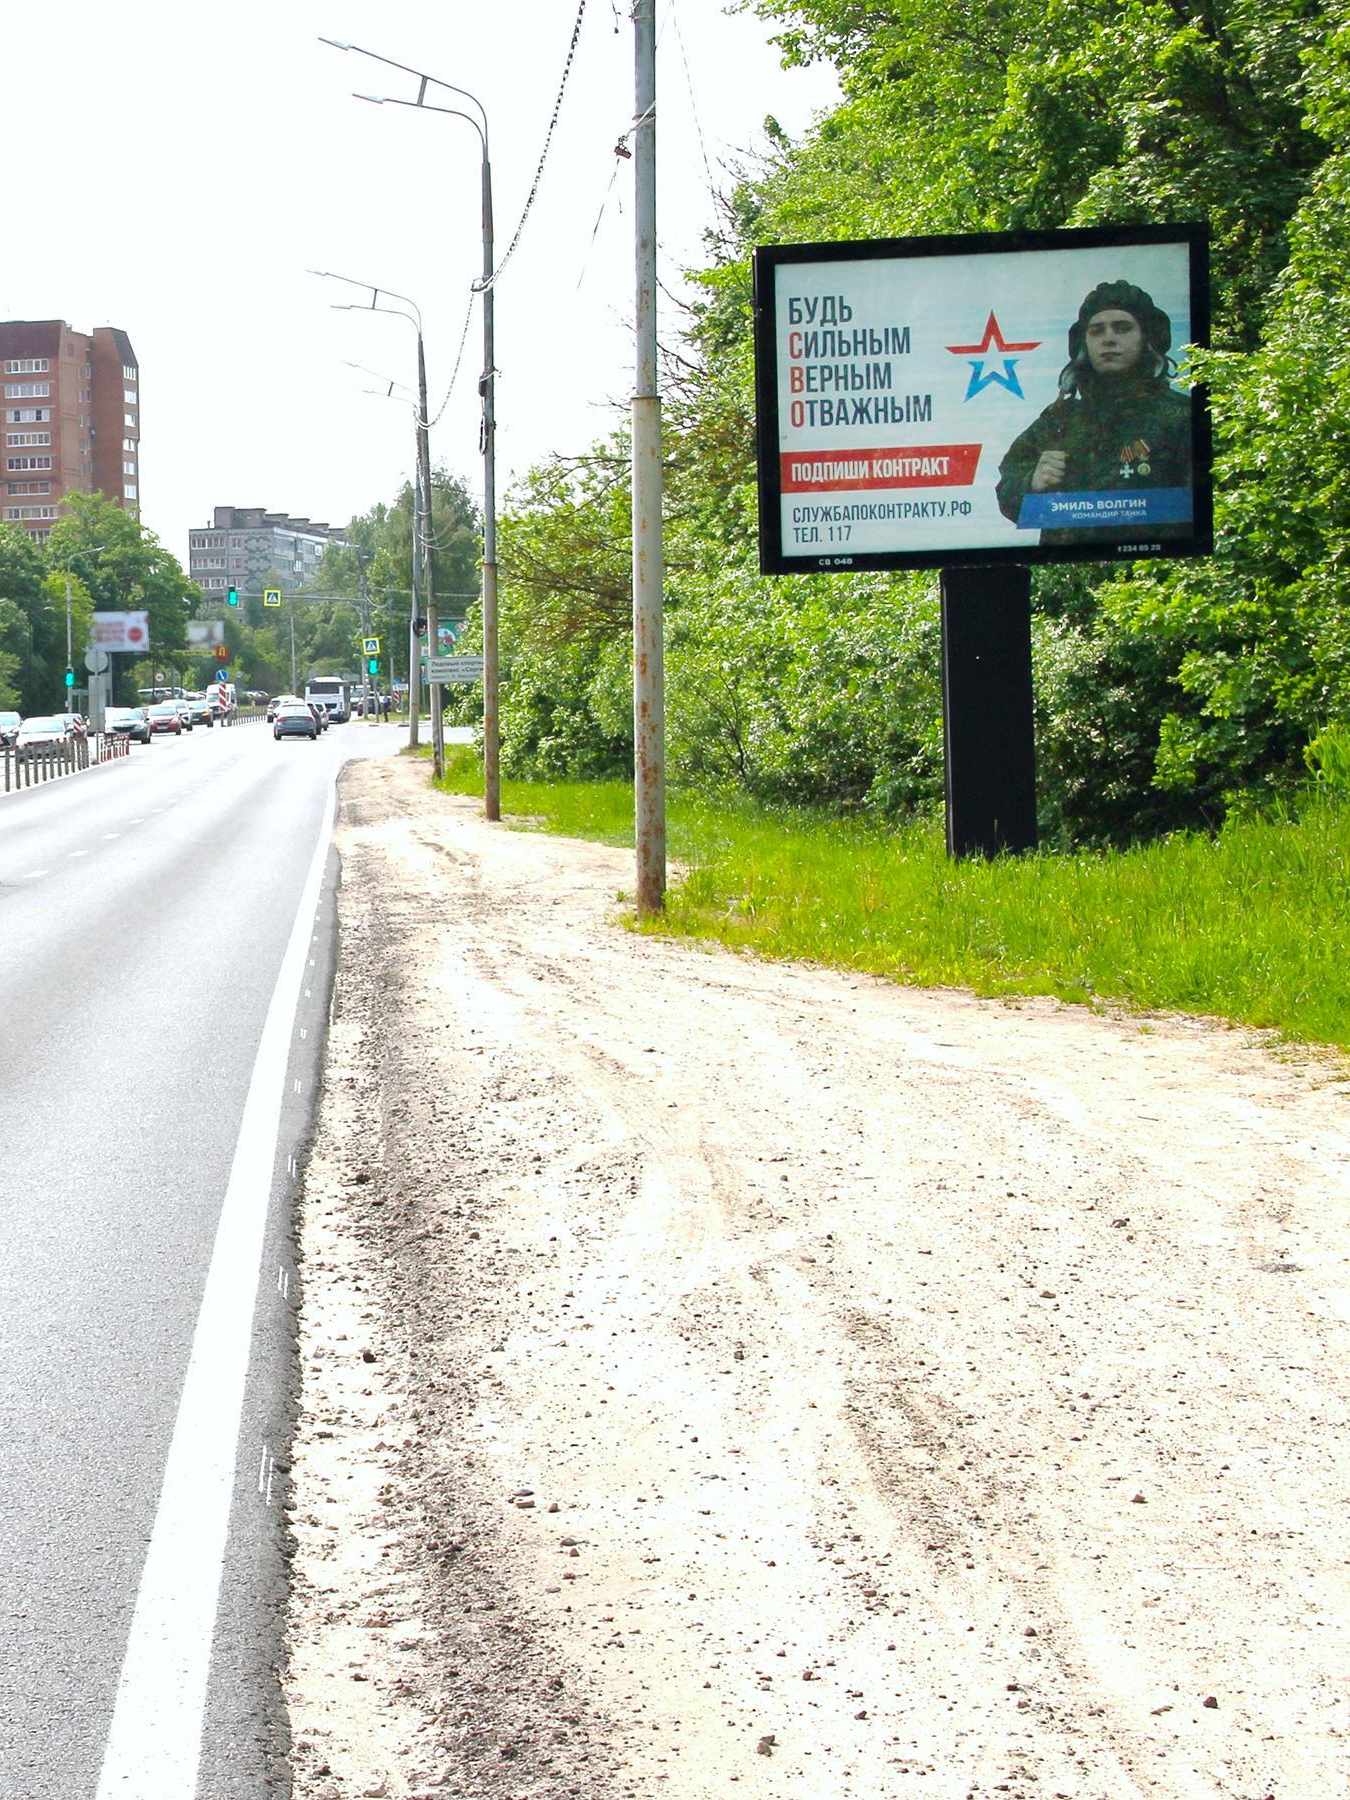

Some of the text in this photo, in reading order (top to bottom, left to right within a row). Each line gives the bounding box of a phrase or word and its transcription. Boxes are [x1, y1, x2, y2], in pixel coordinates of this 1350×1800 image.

[788, 296, 853, 327] БУДЬ
[789, 327, 911, 360] СИЛЬНЫМ
[790, 362, 892, 394] ВЕРНЫМ
[790, 394, 932, 428] ОТВАЖНЫМ
[791, 456, 950, 484] ПОДПИШИ КОНТРАКТ
[792, 500, 973, 524] СЛУЖБАПОКОНТРАКТУ.РФ
[1051, 498, 1147, 512] ЭМИЛЬ ВОЛГИН
[1072, 511, 1119, 519] КОМАНДИР
[793, 525, 852, 543] ТЕЛ. 117
